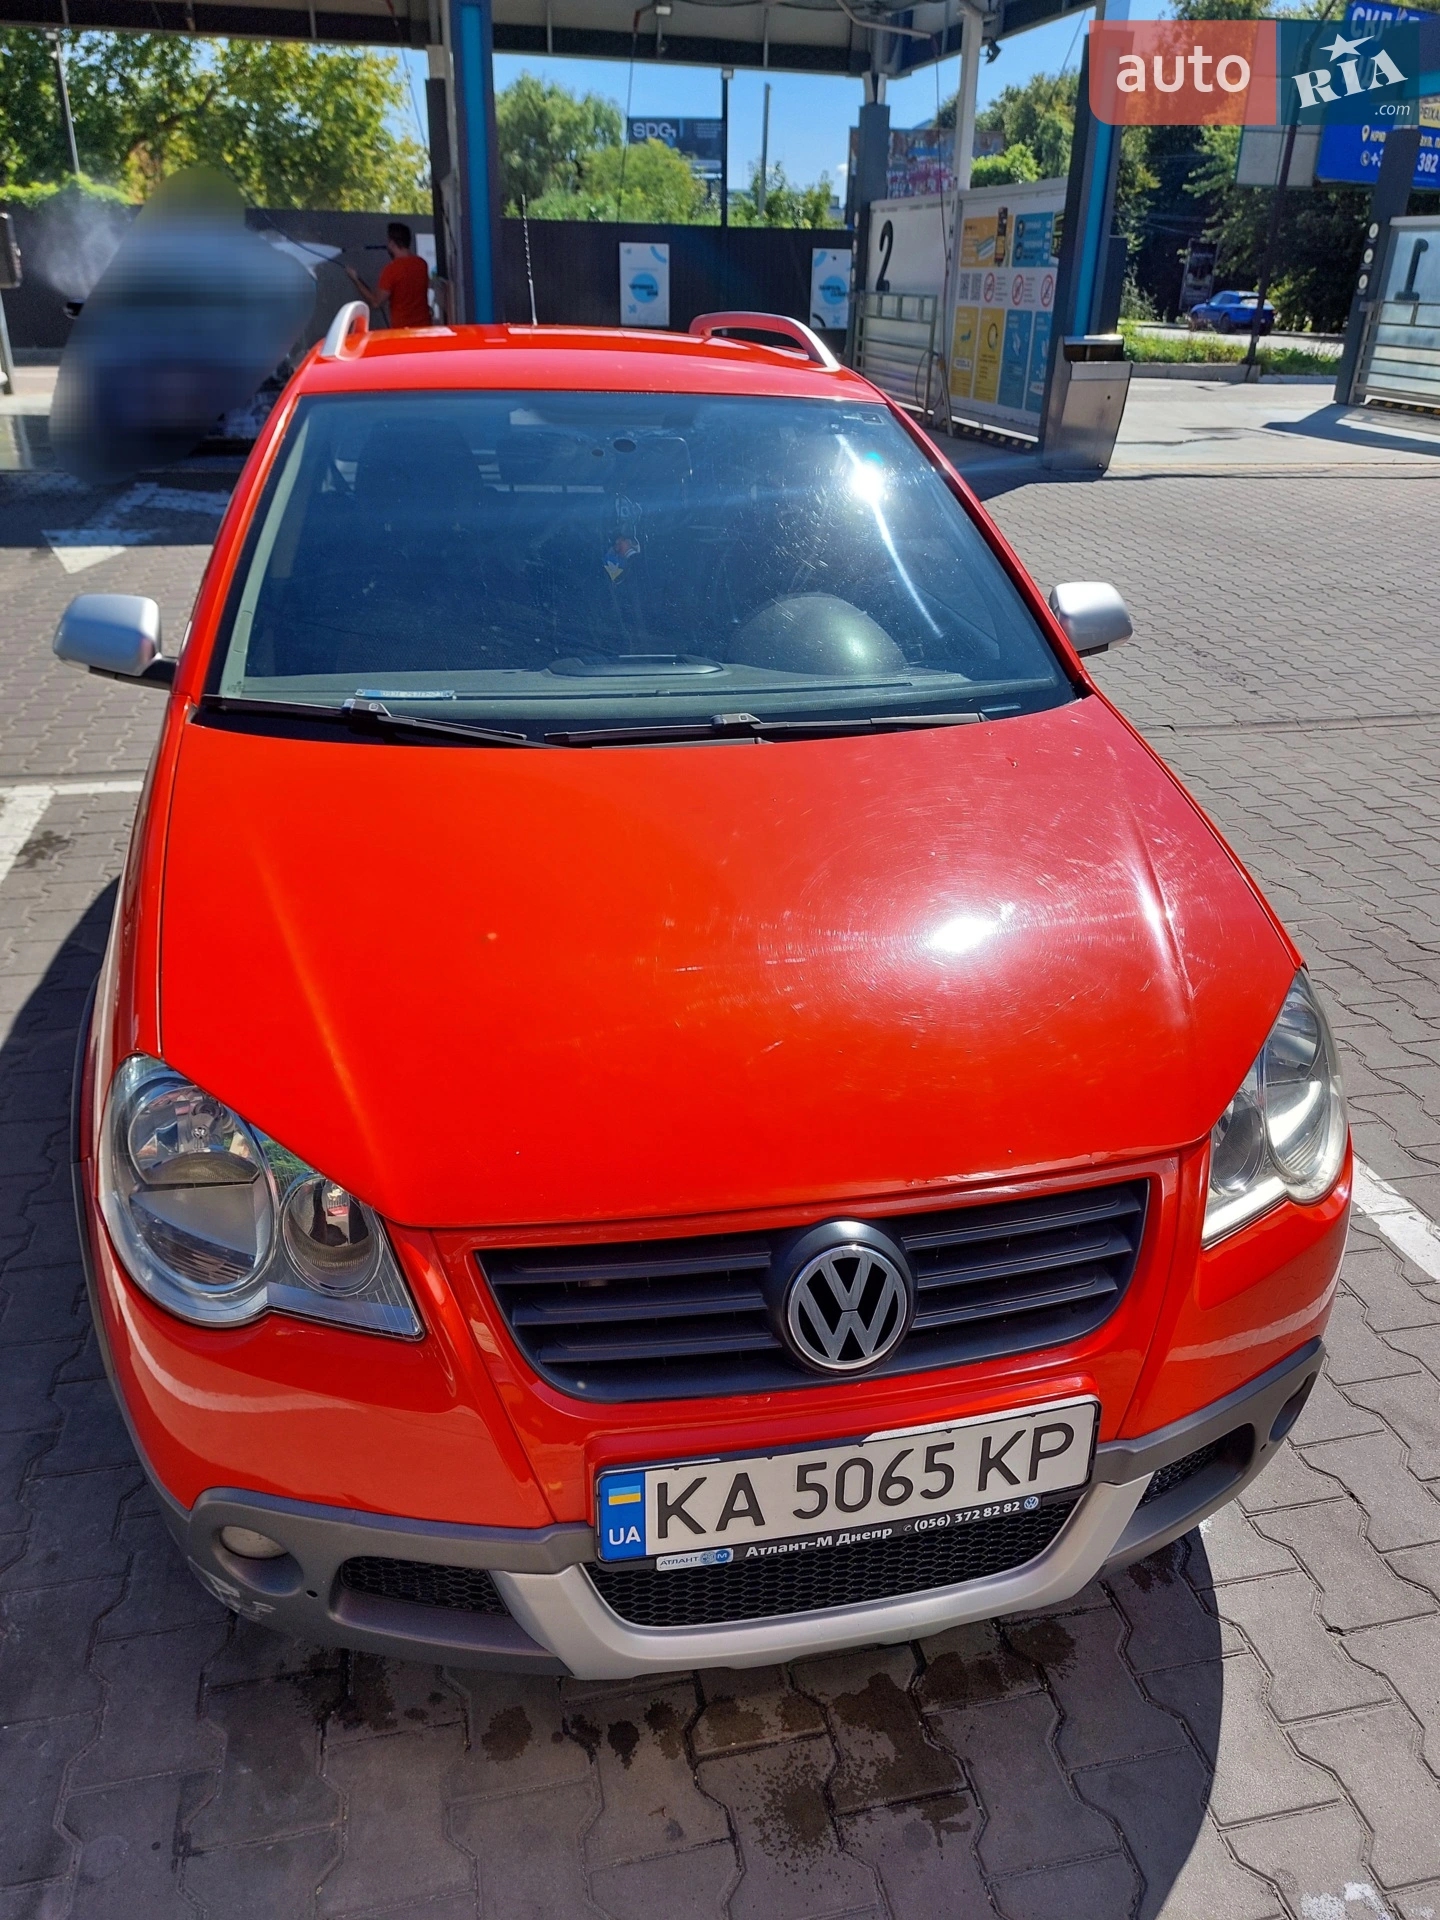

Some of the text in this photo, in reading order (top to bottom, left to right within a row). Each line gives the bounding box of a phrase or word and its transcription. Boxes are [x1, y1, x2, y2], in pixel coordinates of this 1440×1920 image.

[1417, 152, 1439, 173] 382
[876, 219, 893, 291] 2
[1394, 238, 1429, 301] 1
[657, 1422, 1075, 1540] KA 5065 KP
[914, 1501, 1020, 1532] (056) 372 82 82
[608, 1526, 641, 1546] UA
[836, 1528, 893, 1547] Днепр
[660, 1555, 699, 1566] АТЛАНТ
